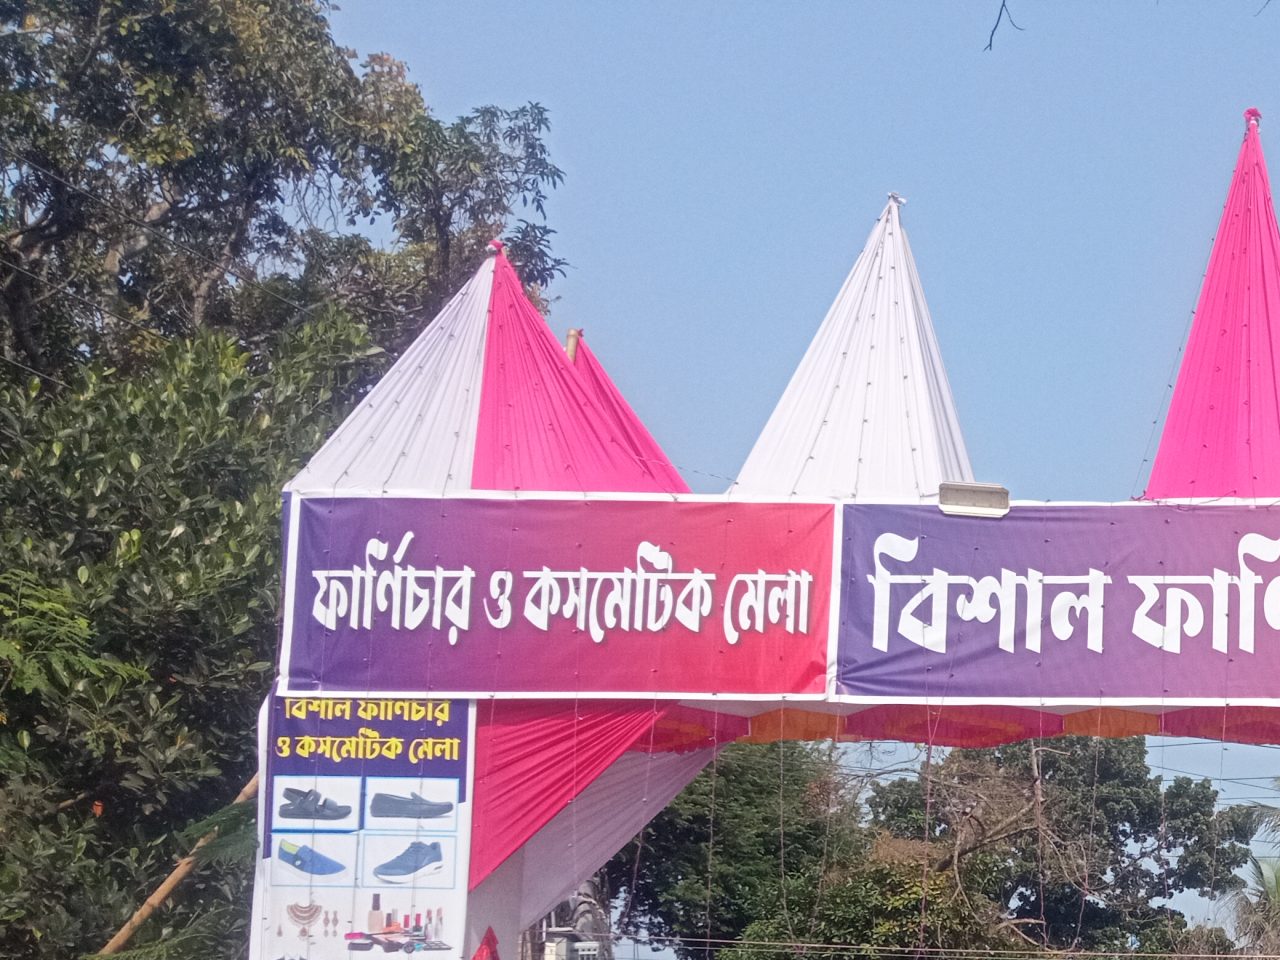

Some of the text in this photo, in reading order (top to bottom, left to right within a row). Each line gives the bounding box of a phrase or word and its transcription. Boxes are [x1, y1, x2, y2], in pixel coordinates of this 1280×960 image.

[483, 570, 513, 629] ও
[523, 541, 716, 643] কসমেটিক
[723, 569, 813, 645] মেলা
[866, 532, 1113, 654] বিশাল
[275, 727, 461, 764] ও কসমেটিক মেলা
